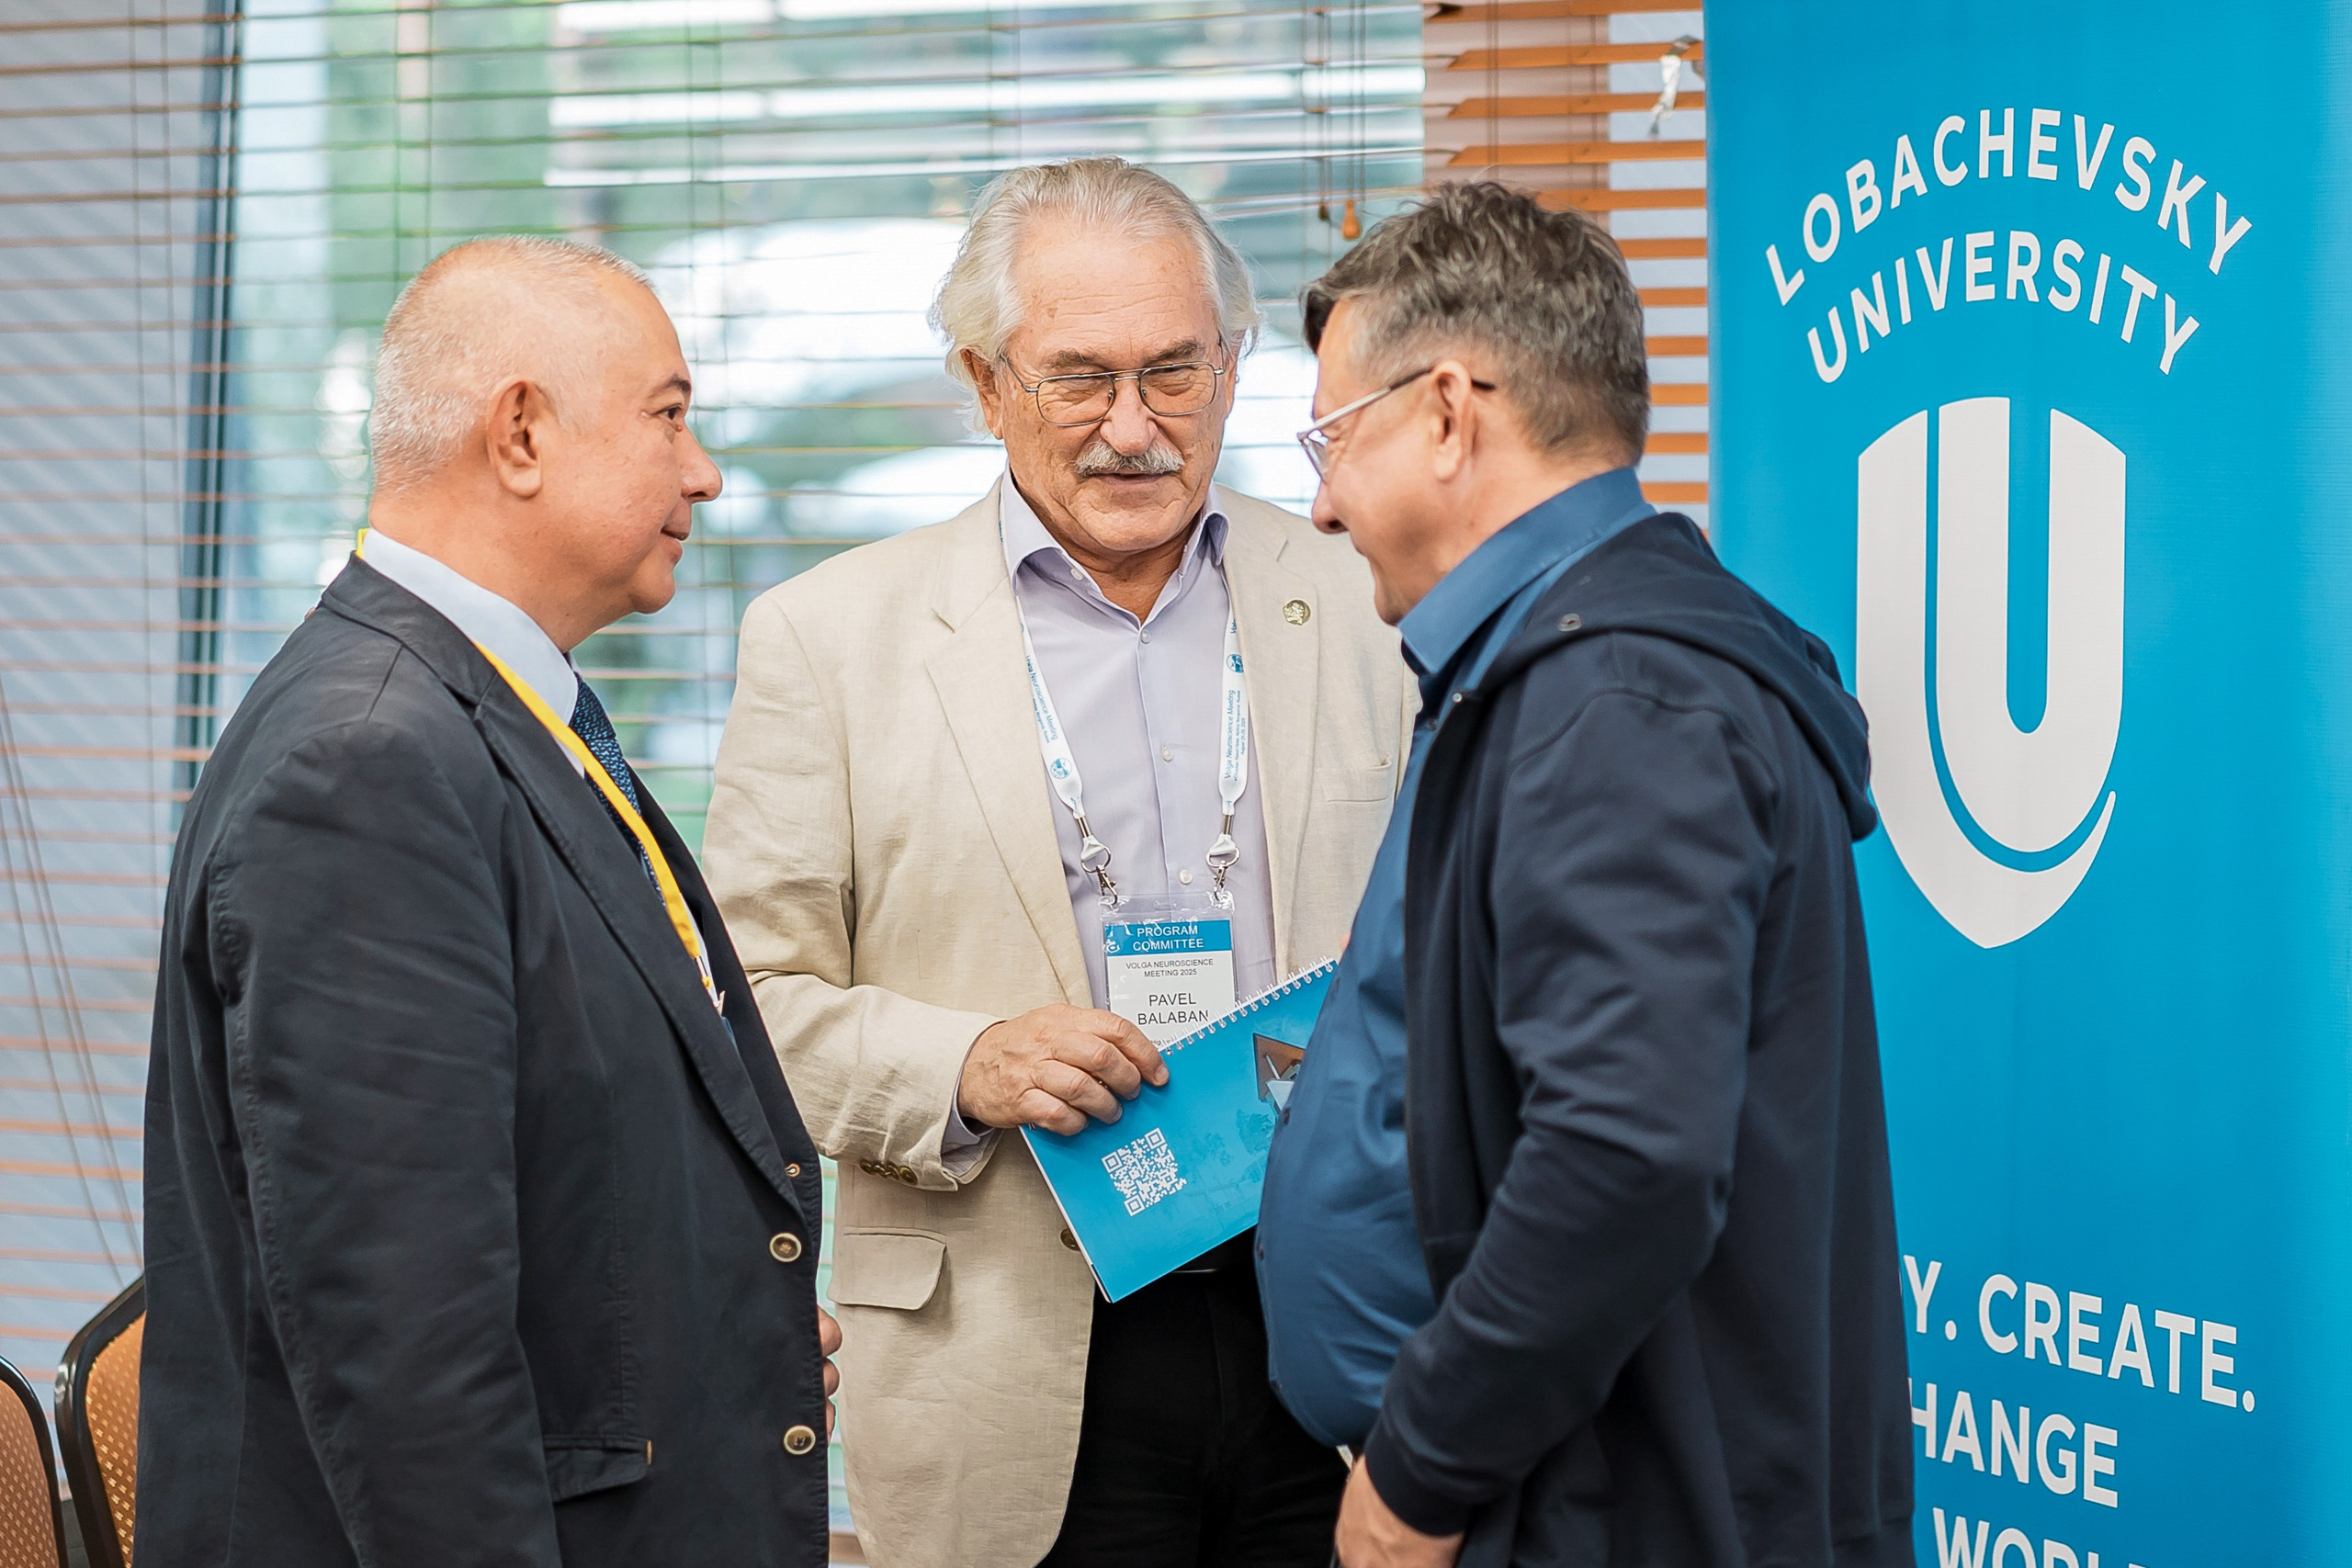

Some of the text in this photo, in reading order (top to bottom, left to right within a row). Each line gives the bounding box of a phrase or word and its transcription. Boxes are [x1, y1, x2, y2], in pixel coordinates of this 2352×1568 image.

[1765, 107, 2253, 307] LOBACHEVSKY
[1806, 231, 2200, 384] UNIVERSITY
[1227, 689, 1237, 715] Meeting
[1224, 760, 1235, 780] Volga
[1136, 926, 1198, 937] PROGRAM
[1133, 939, 1204, 951] COMMITTEE
[1125, 958, 1214, 970] VOLGA NEUROSCIENCE
[1180, 968, 1198, 976] 2025
[1148, 992, 1197, 1007] PAVEL
[1137, 1010, 1209, 1025] BALABAN
[1899, 1254, 2256, 1414] Y. CREATE.
[1908, 1377, 2119, 1509] HANGE
